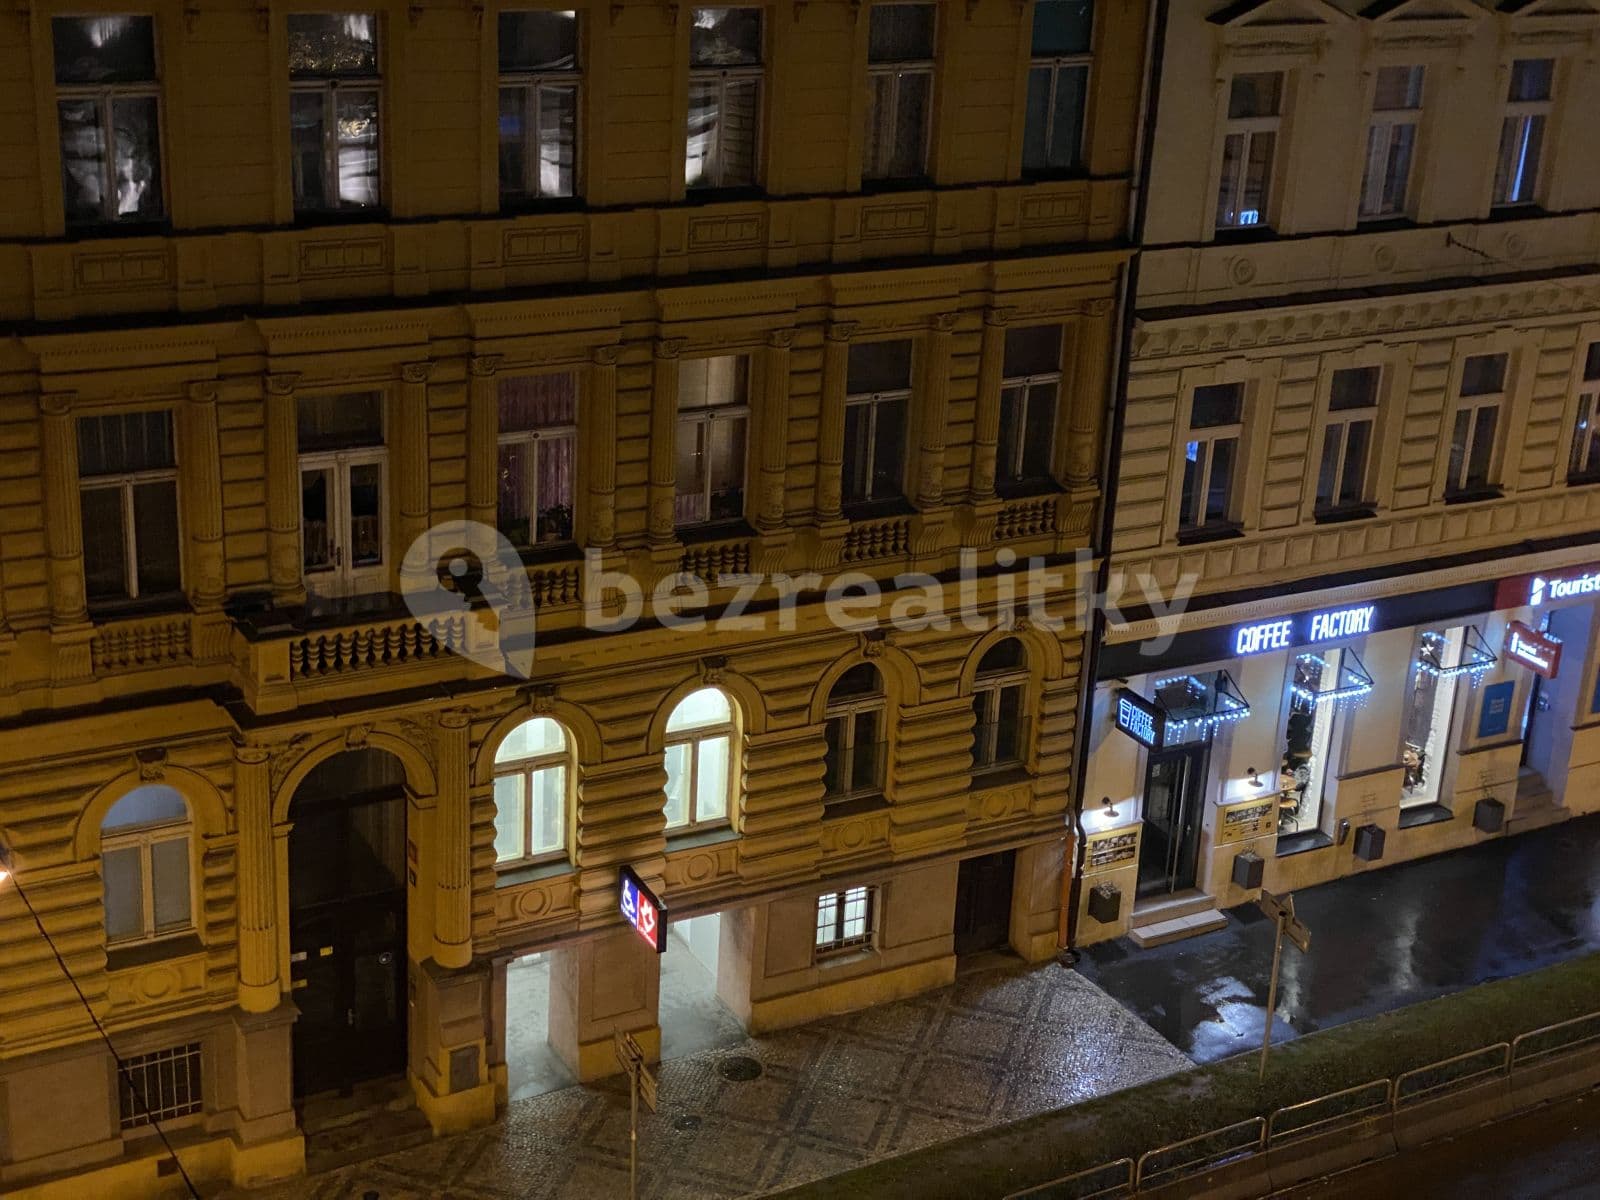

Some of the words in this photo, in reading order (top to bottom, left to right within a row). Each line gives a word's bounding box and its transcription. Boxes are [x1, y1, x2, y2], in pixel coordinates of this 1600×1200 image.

[1236, 620, 1292, 654] COFFEE
[1310, 606, 1375, 641] FACTORY
[1131, 705, 1154, 730] COFFEE
[1129, 718, 1156, 745] FACTORY
